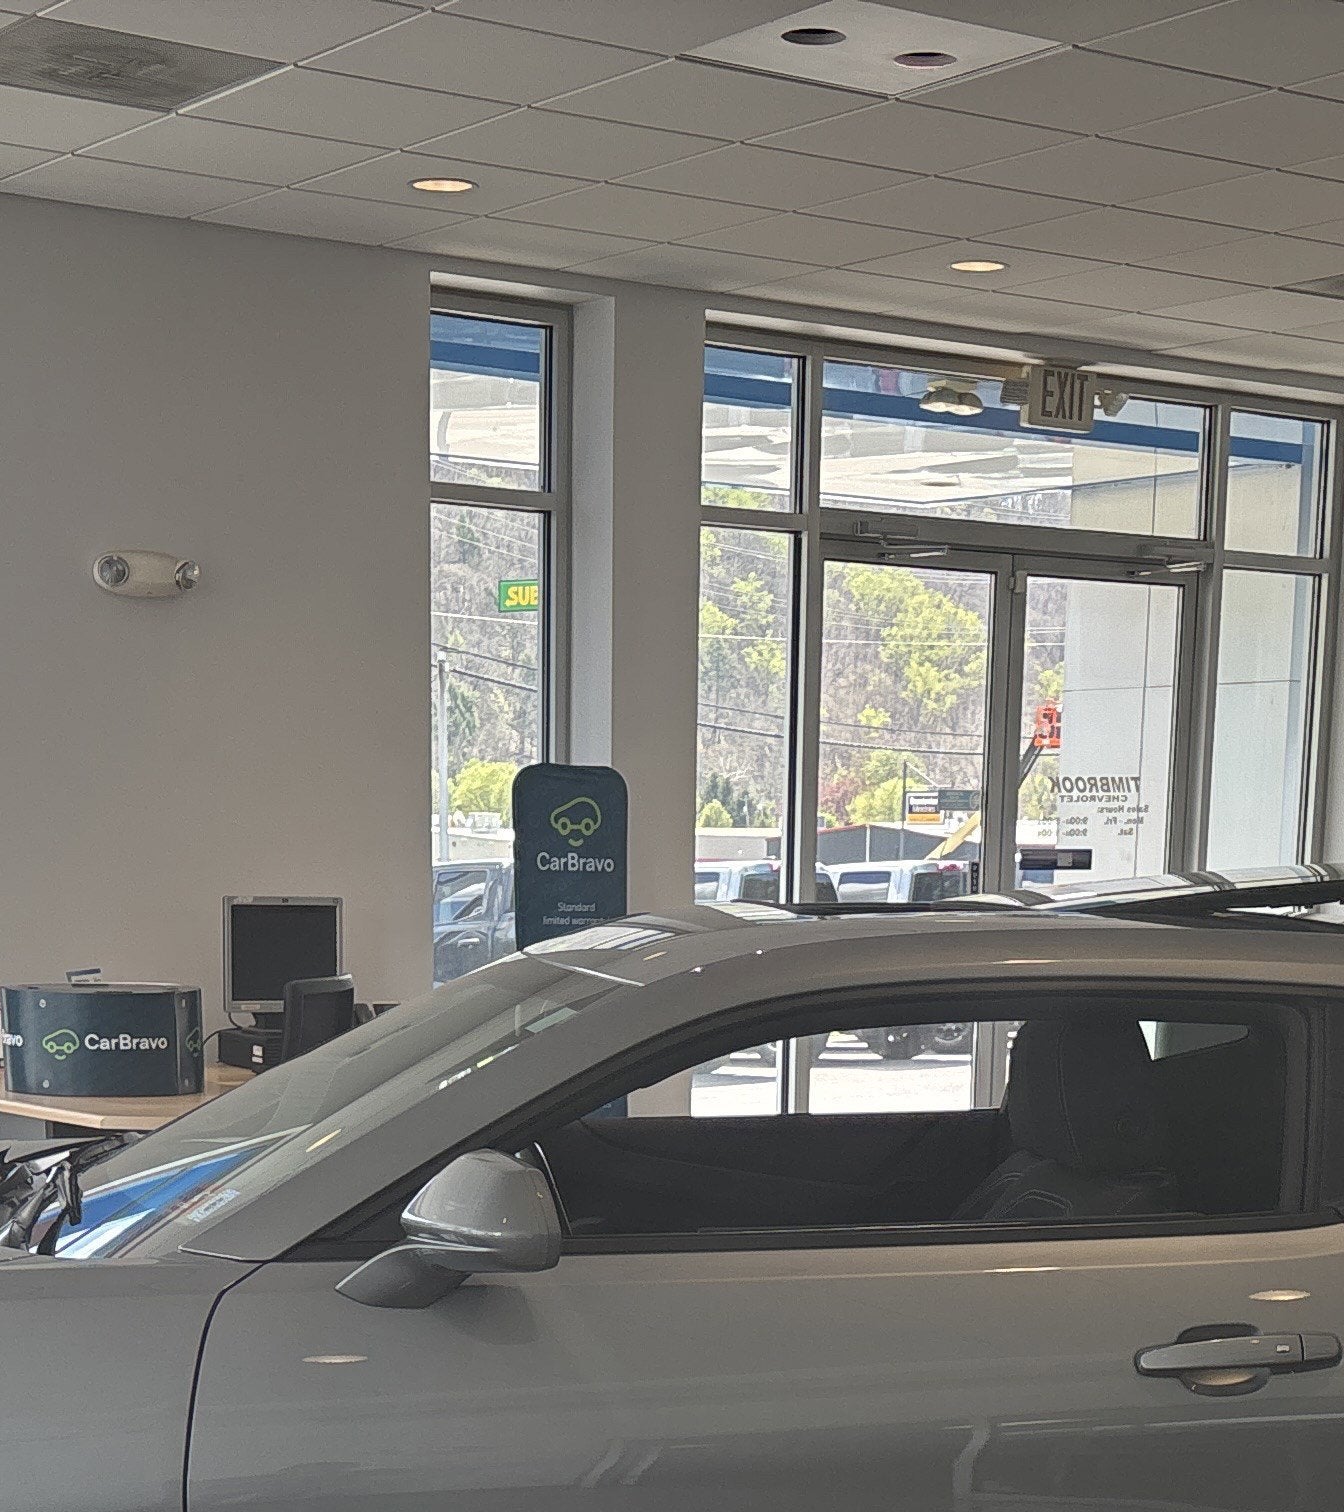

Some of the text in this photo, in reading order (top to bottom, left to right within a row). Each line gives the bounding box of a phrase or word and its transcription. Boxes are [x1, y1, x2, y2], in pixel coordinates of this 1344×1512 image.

[1041, 369, 1089, 421] EXIT
[537, 851, 615, 873] CarBravo
[557, 902, 596, 912] Standard
[542, 915, 571, 926] limited
[84, 1033, 168, 1051] CarBravo
